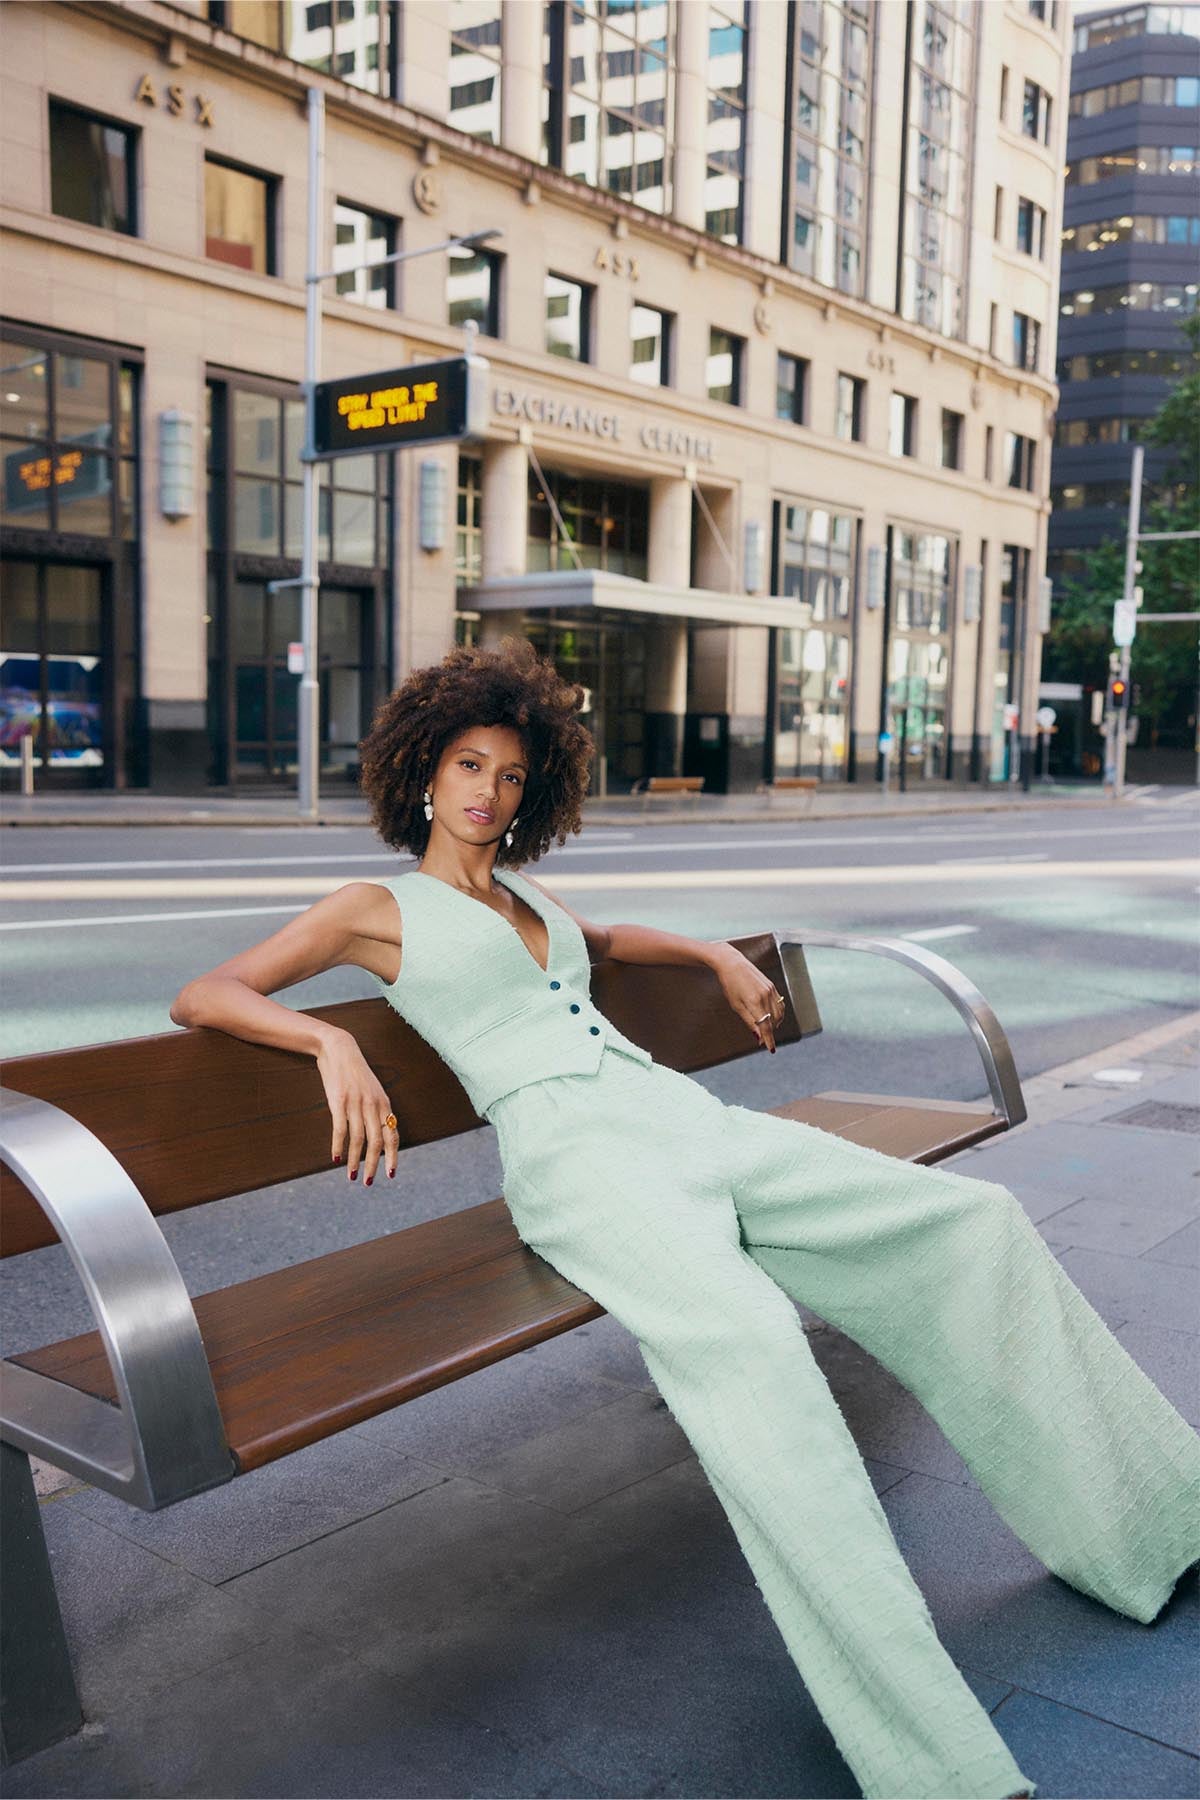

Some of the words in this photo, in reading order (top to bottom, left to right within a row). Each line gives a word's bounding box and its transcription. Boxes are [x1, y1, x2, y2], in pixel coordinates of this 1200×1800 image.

[133, 73, 216, 129] ASX
[593, 246, 641, 283] ASX
[412, 381, 438, 402] THE
[388, 401, 427, 425] LIMIT
[493, 388, 621, 441] EXCHANGE
[639, 425, 715, 463] CENTRE
